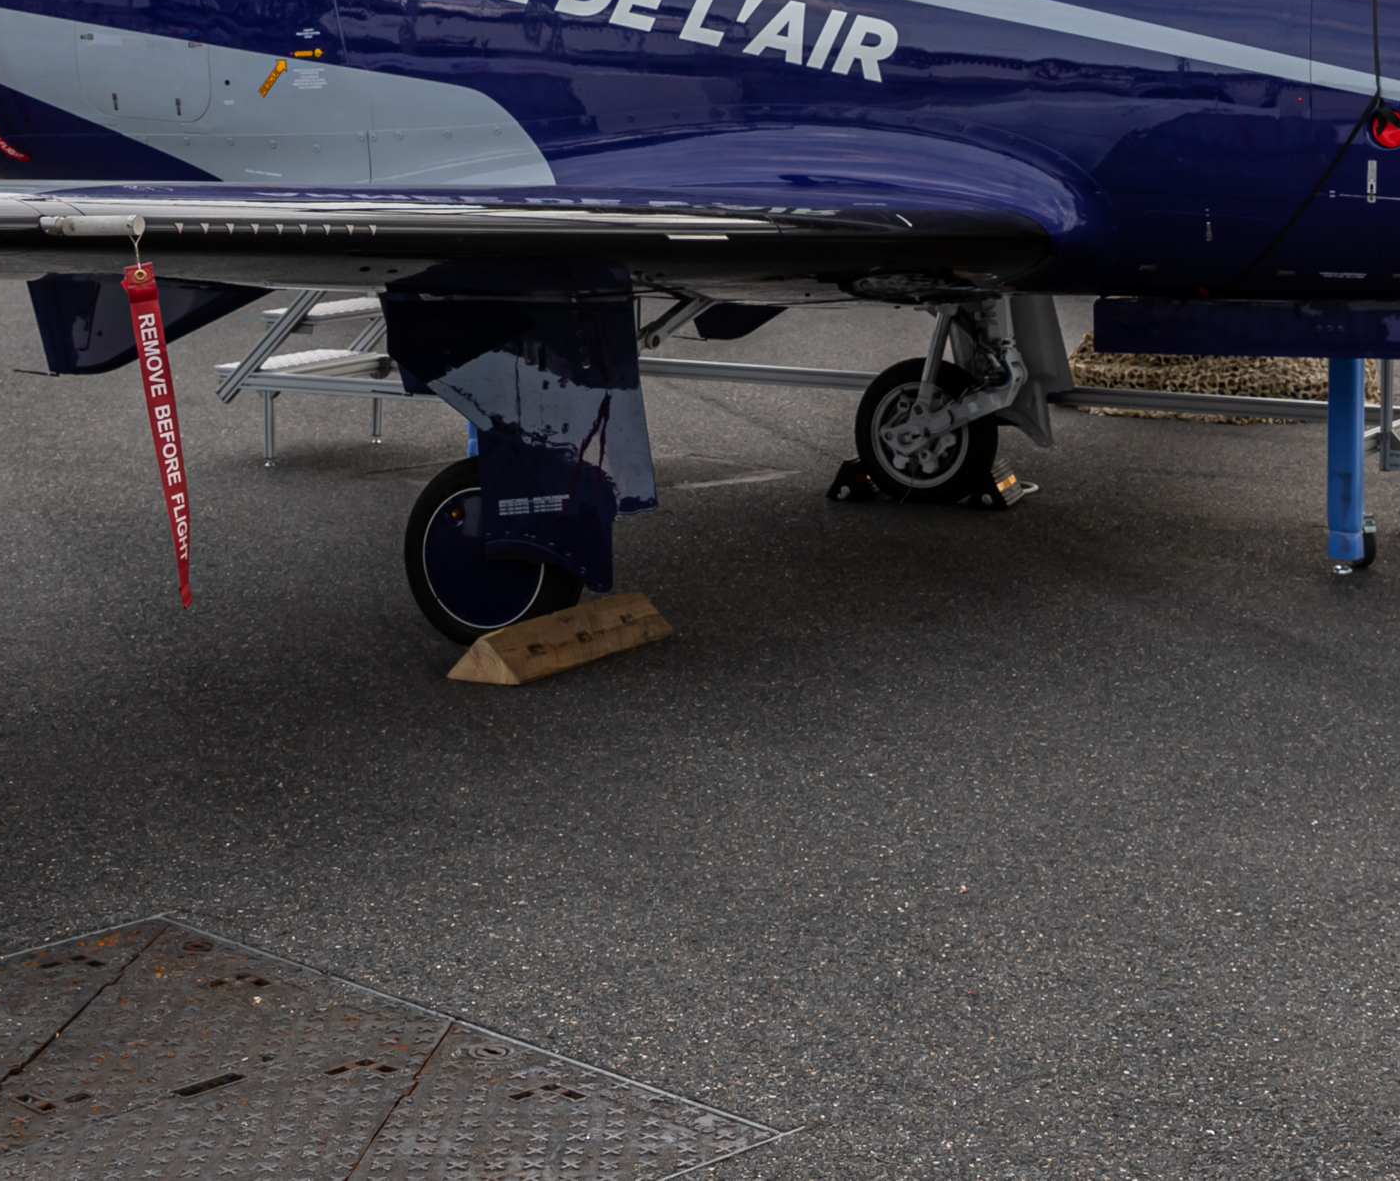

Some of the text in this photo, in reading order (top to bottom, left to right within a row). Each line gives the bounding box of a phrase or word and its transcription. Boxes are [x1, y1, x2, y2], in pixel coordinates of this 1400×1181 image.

[138, 313, 189, 561] REMOVE BEFORE FLIGHT
